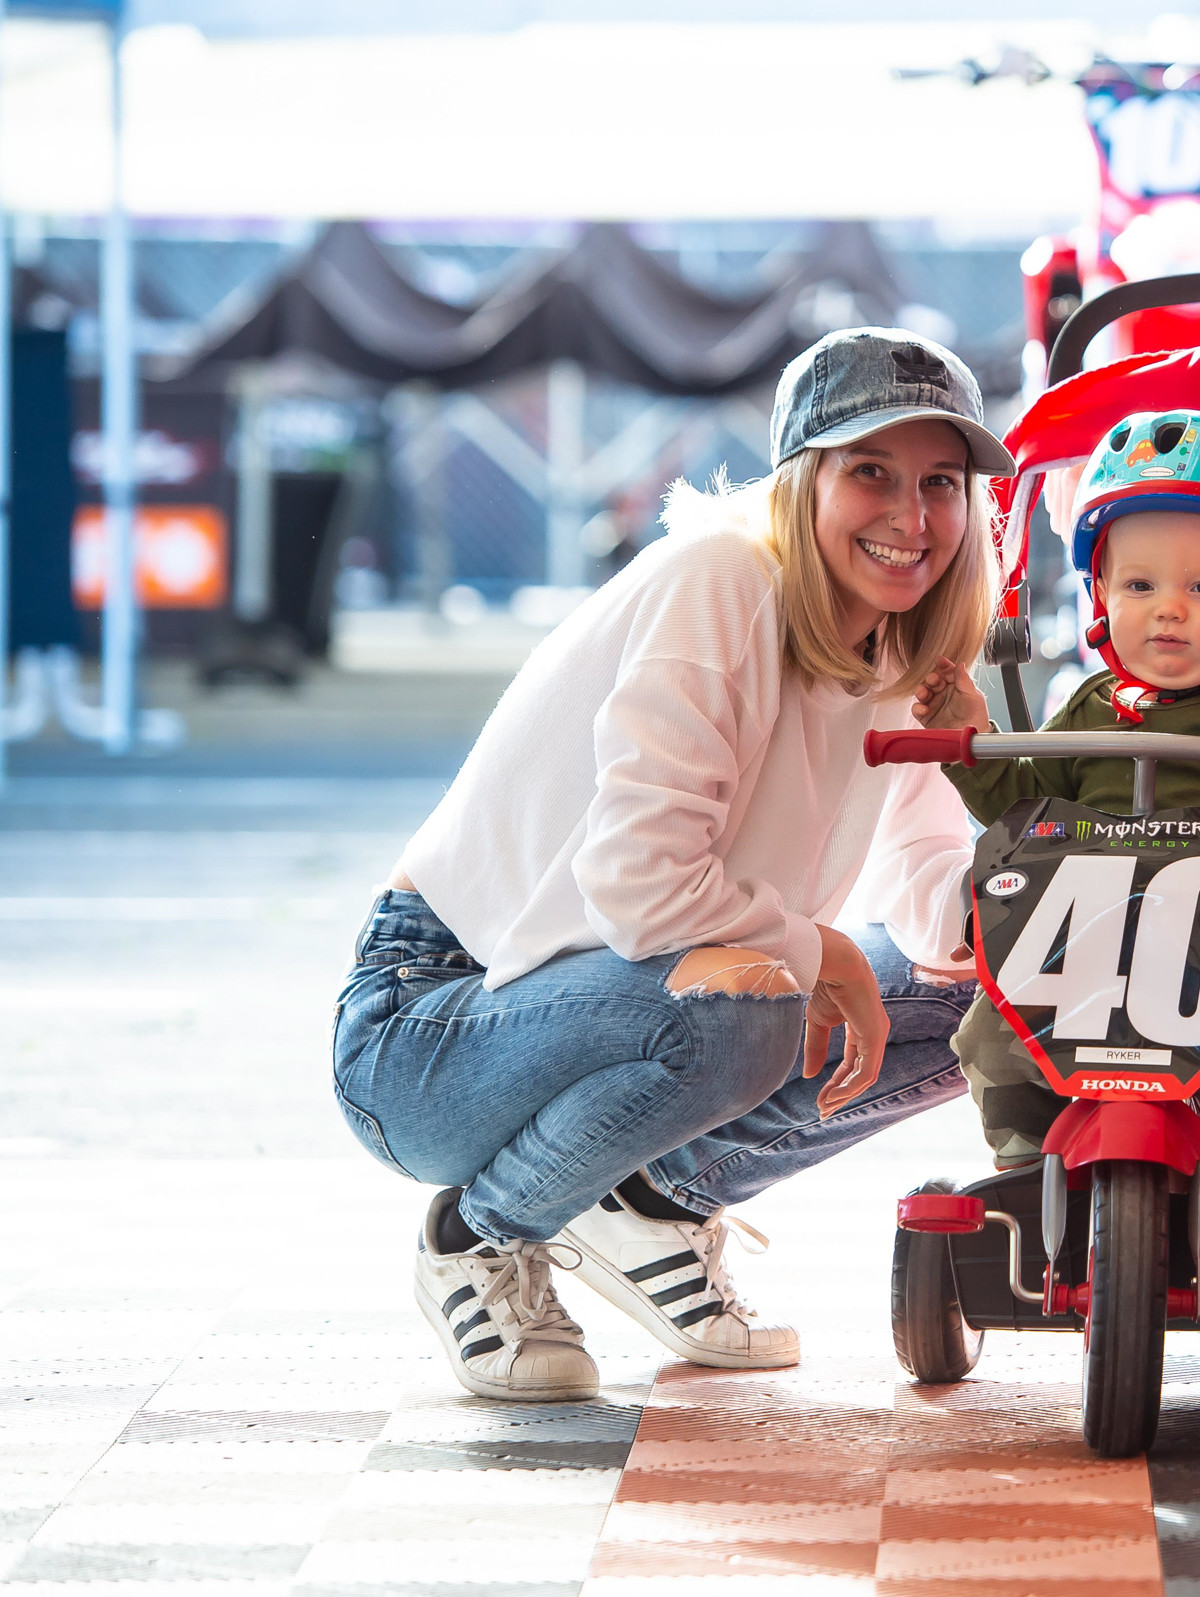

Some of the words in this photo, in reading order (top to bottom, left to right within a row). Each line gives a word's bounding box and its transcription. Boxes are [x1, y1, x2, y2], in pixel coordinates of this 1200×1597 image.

[1022, 821, 1066, 839] AMA
[1109, 840, 1190, 848] ENERGY
[992, 877, 1018, 890] AMA
[1106, 1051, 1141, 1061] RYKER
[1080, 1079, 1166, 1093] HONDA
